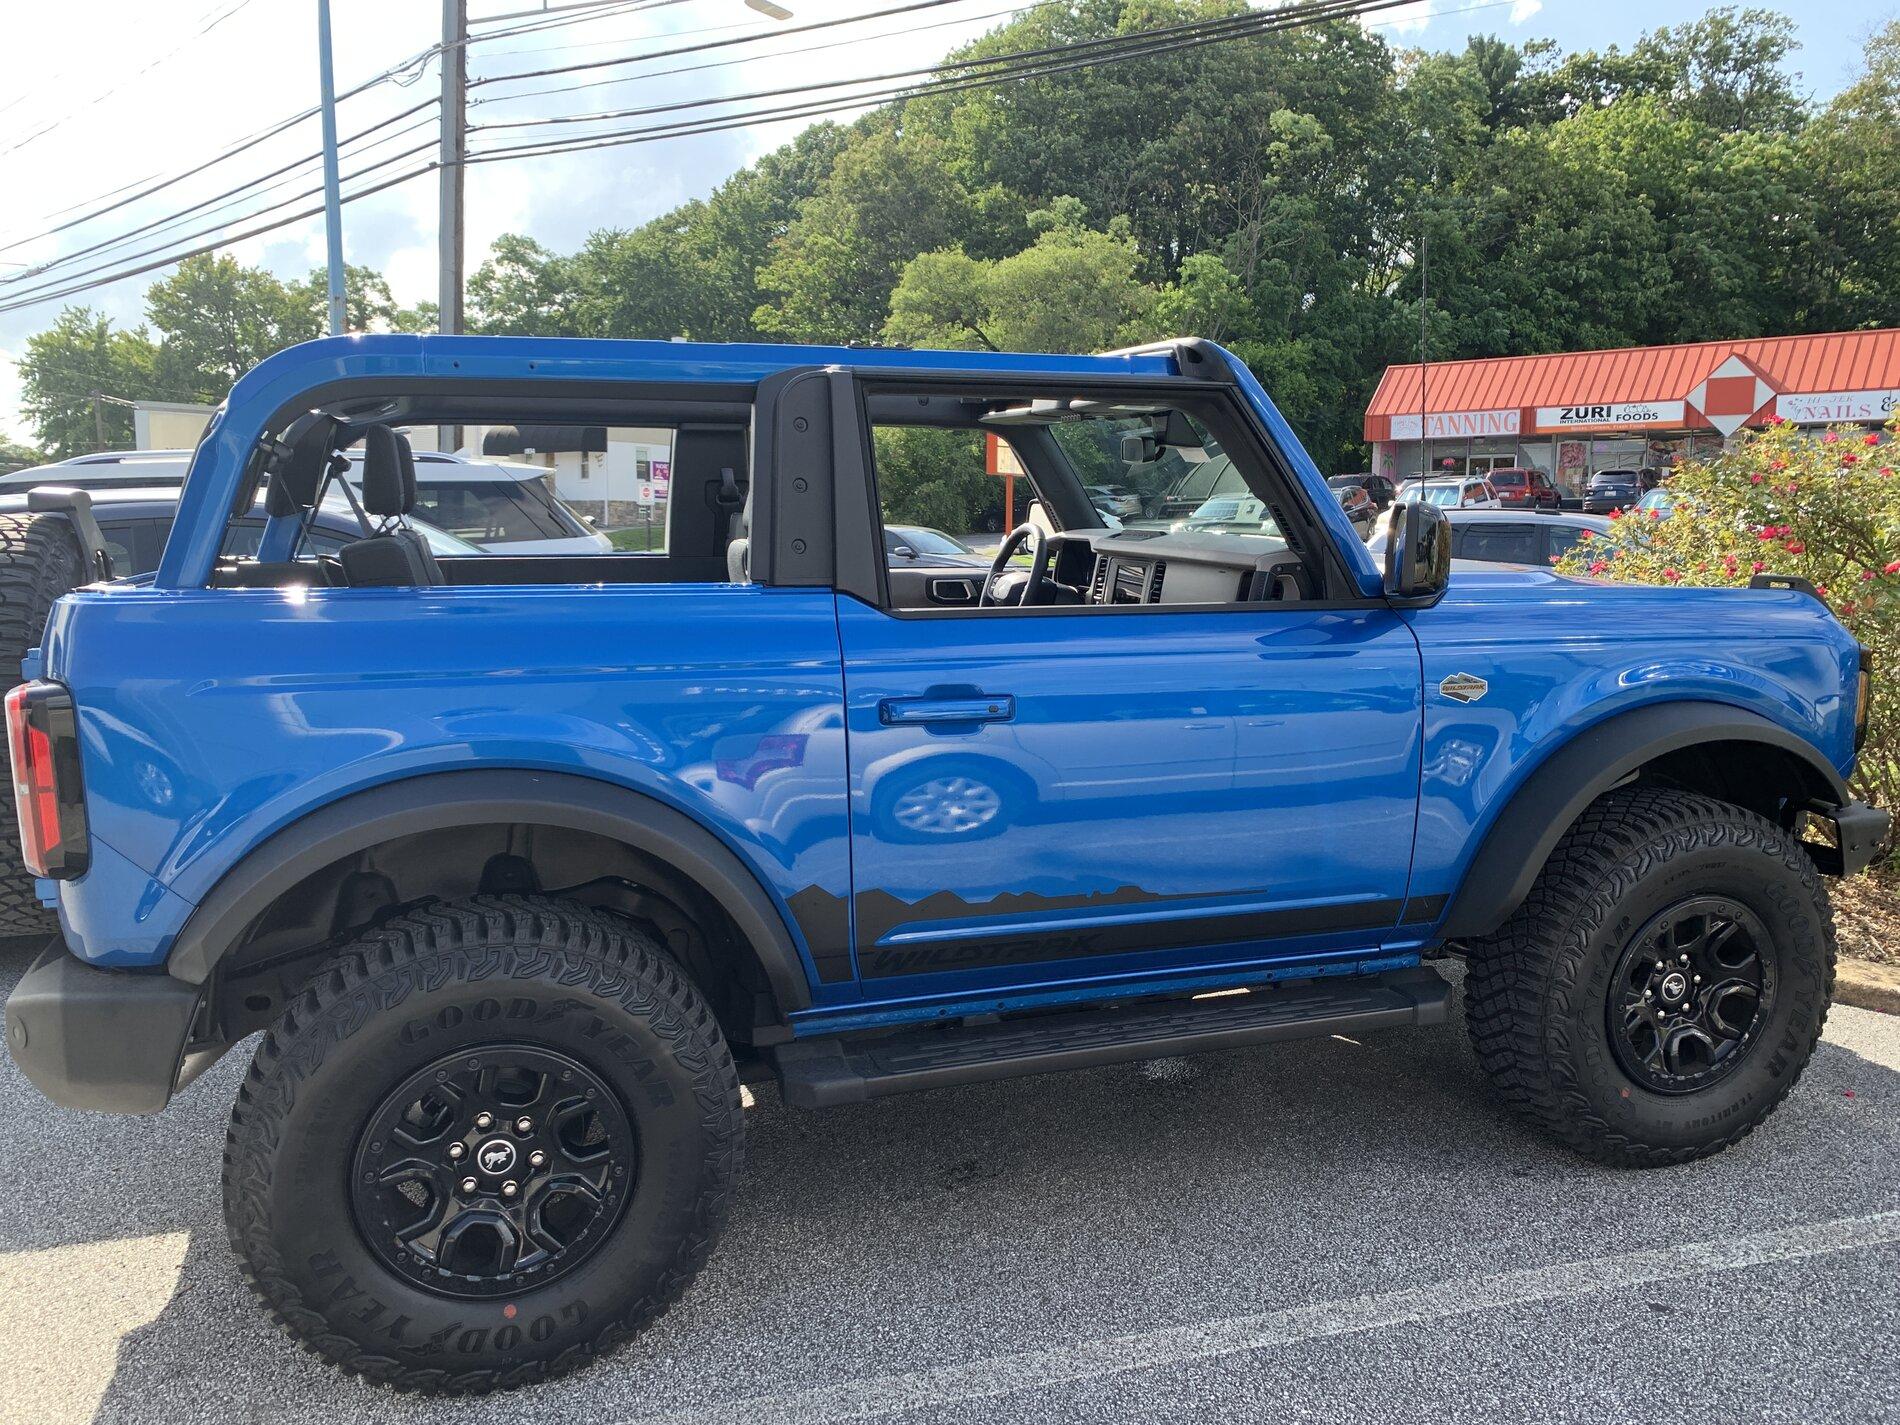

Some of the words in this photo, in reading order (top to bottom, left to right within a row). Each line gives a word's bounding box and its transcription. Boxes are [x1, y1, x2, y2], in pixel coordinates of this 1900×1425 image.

[1560, 406, 1611, 420] ZURI
[1616, 412, 1659, 421] FOODS
[1803, 404, 1872, 420] NAILS
[1423, 411, 1517, 436] TANNING
[873, 934, 1106, 970] WILDTRAK
